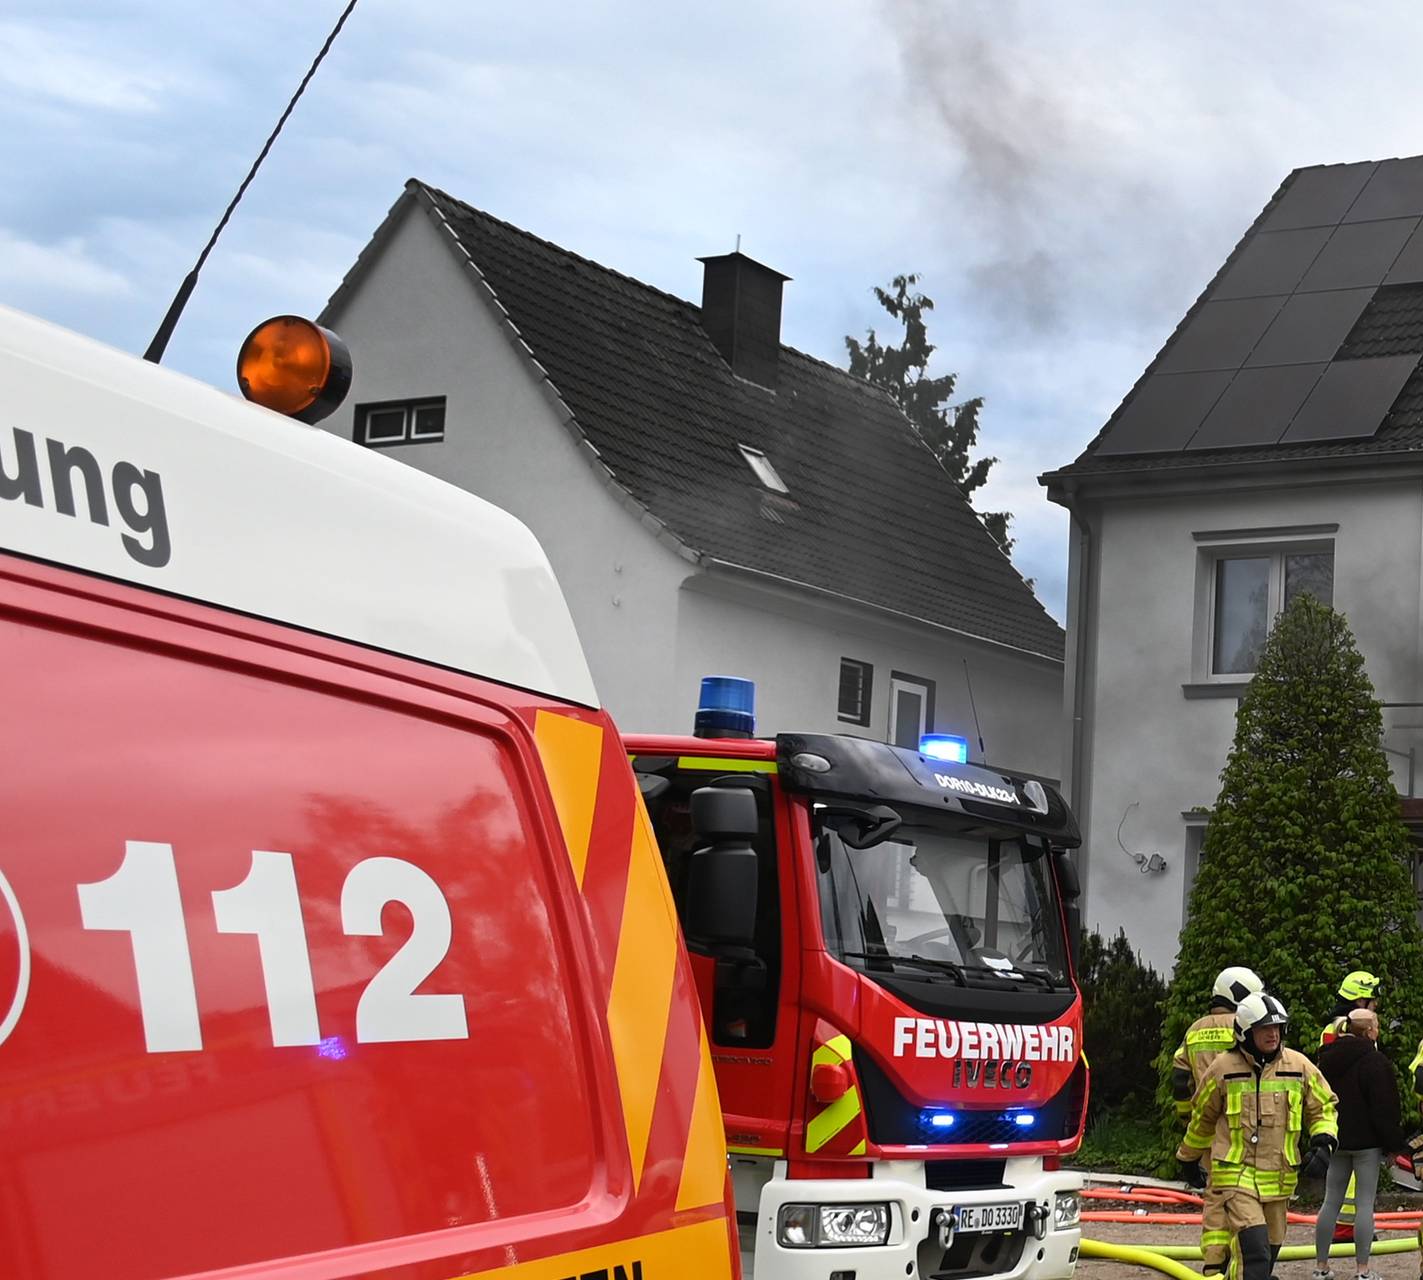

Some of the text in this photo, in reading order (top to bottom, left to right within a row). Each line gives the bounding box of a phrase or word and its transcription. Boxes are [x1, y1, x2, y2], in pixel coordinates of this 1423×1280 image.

[77, 840, 469, 1053] 112
[893, 1017, 1073, 1062] FEUERWEHR
[952, 1060, 1032, 1088] IVECO
[961, 1209, 974, 1228] RE
[981, 1208, 994, 1227] DO
